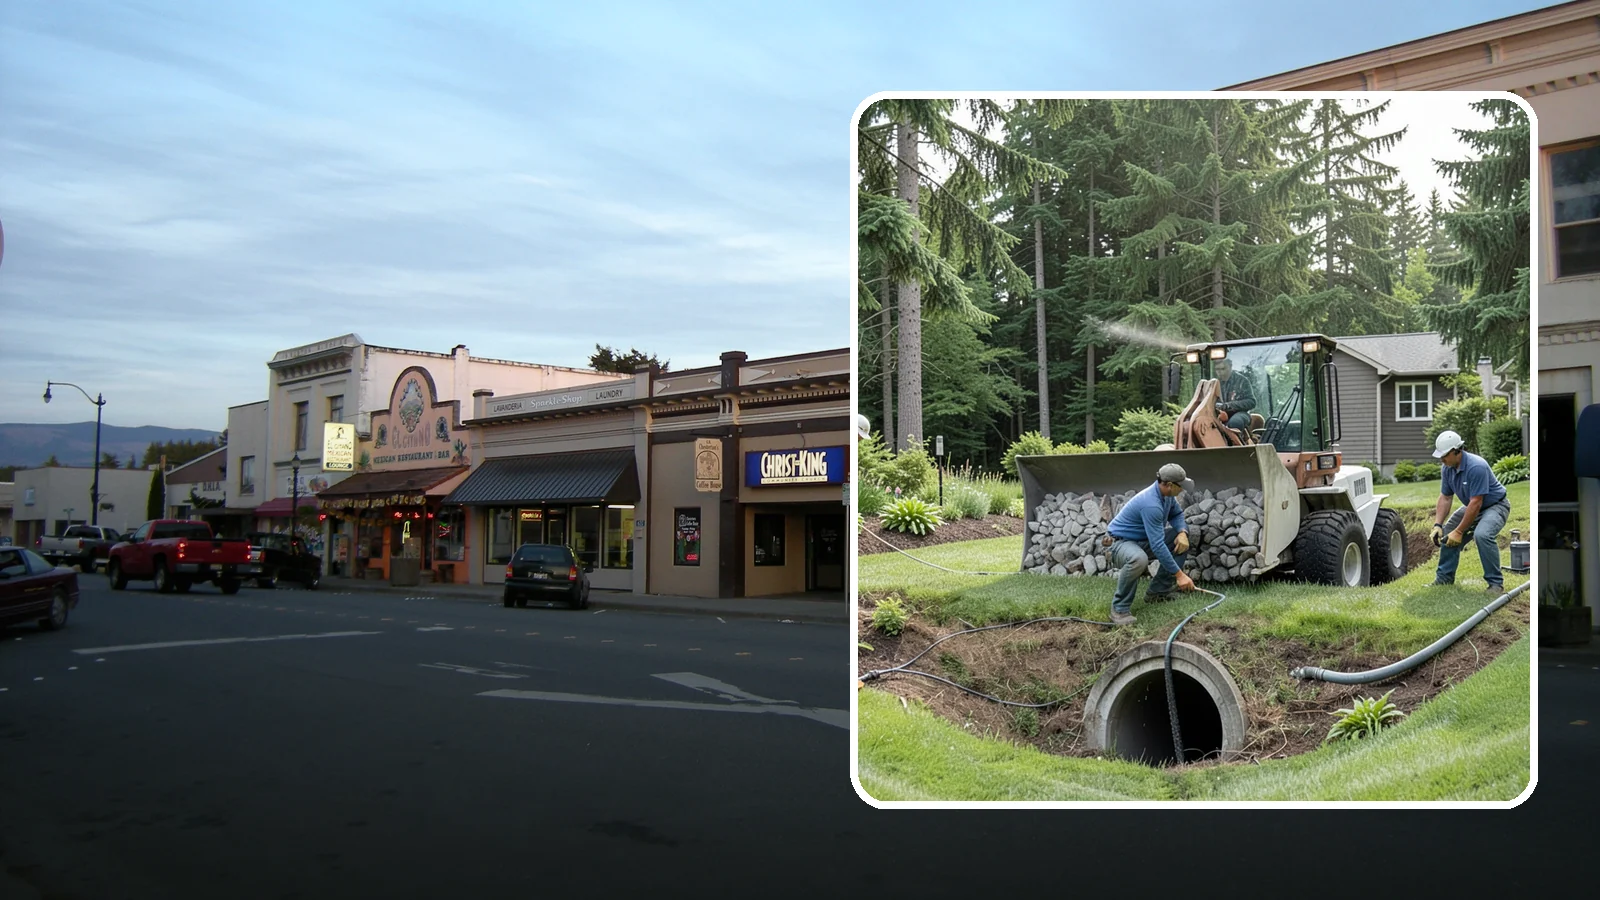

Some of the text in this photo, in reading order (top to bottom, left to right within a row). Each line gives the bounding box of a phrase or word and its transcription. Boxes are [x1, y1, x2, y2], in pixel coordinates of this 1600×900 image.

[561, 394, 583, 405] Shop
[595, 389, 624, 400] LAUNDRY
[493, 402, 522, 413] LAVANDERIA
[374, 450, 450, 465] MEXICAN RESTAURANT BAR
[761, 450, 827, 478] CHRIST KING
